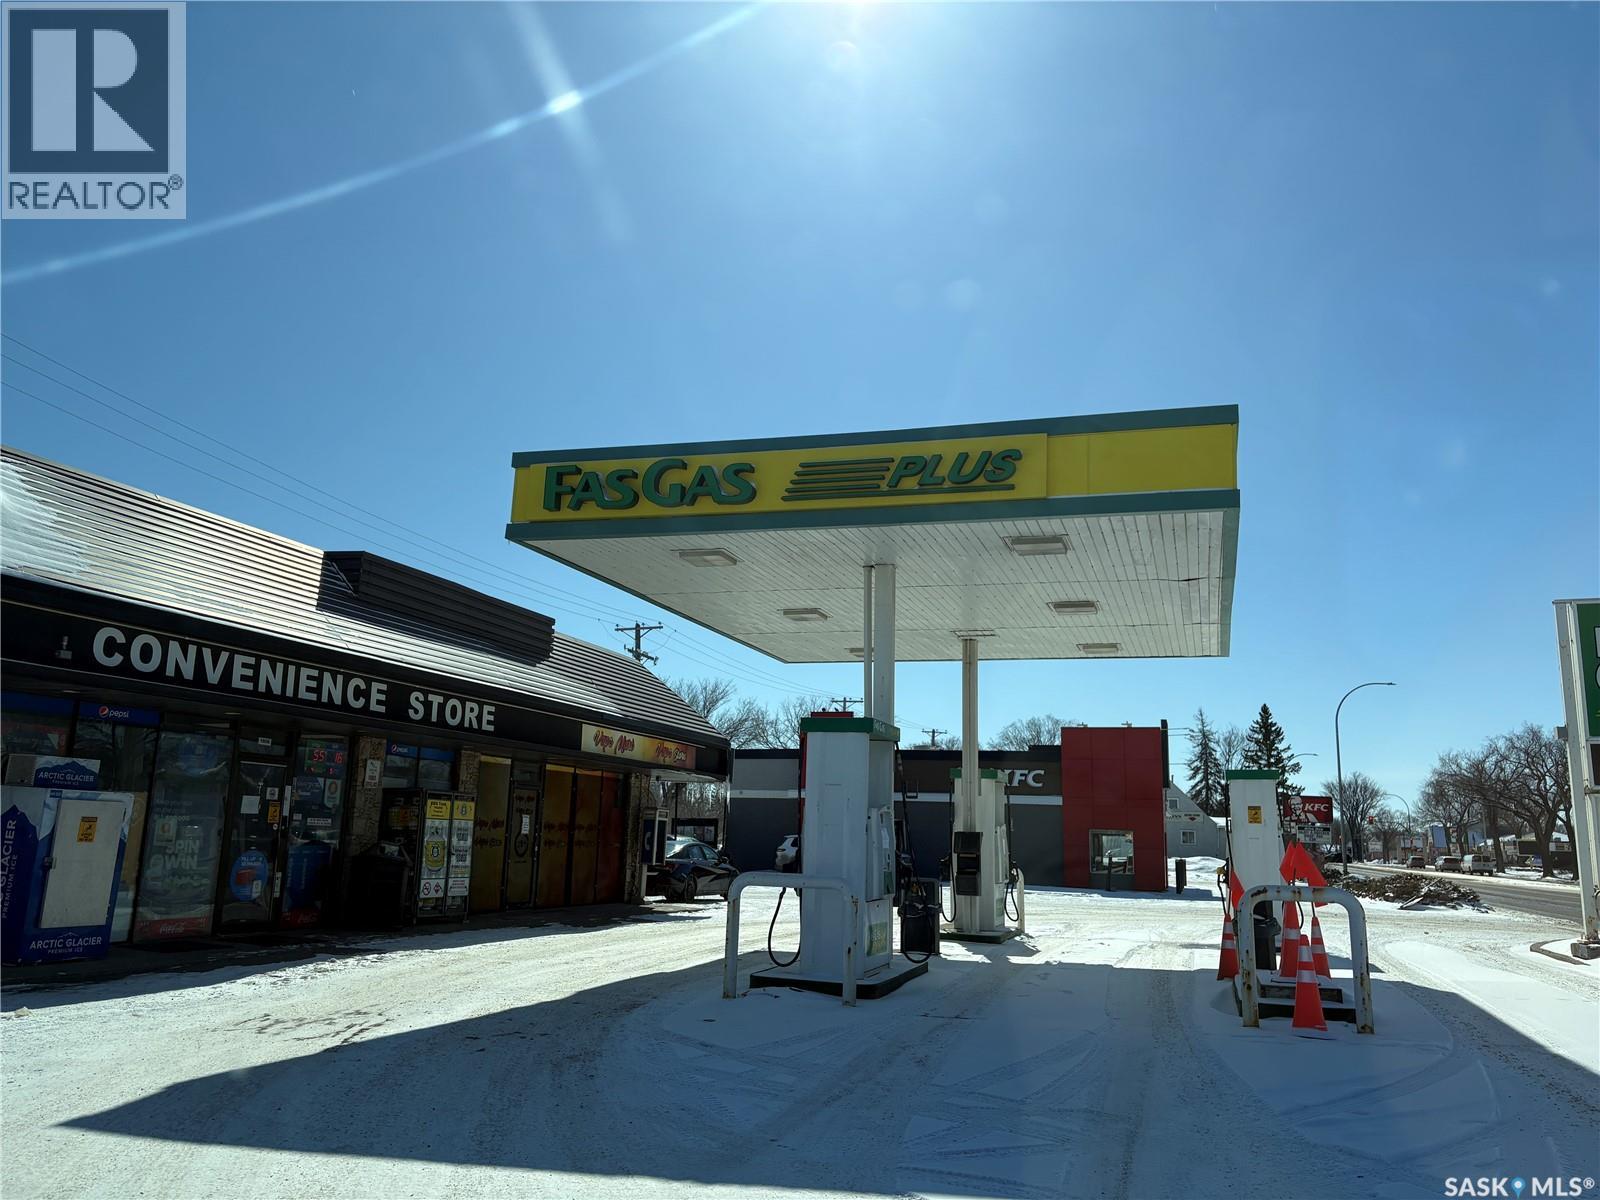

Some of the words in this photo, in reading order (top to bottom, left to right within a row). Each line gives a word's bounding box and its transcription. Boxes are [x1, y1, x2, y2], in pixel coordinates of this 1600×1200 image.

[887, 448, 1023, 489] PLUS
[92, 626, 388, 714] CONVENIENCE
[408, 691, 496, 732] STORE
[108, 709, 129, 719] pepsi
[37, 771, 65, 780] ARCTIC
[65, 773, 95, 782] GLACIER
[1304, 803, 1329, 812] KFC
[29, 938, 63, 950] ARCTIC
[65, 936, 103, 948] GLACIER
